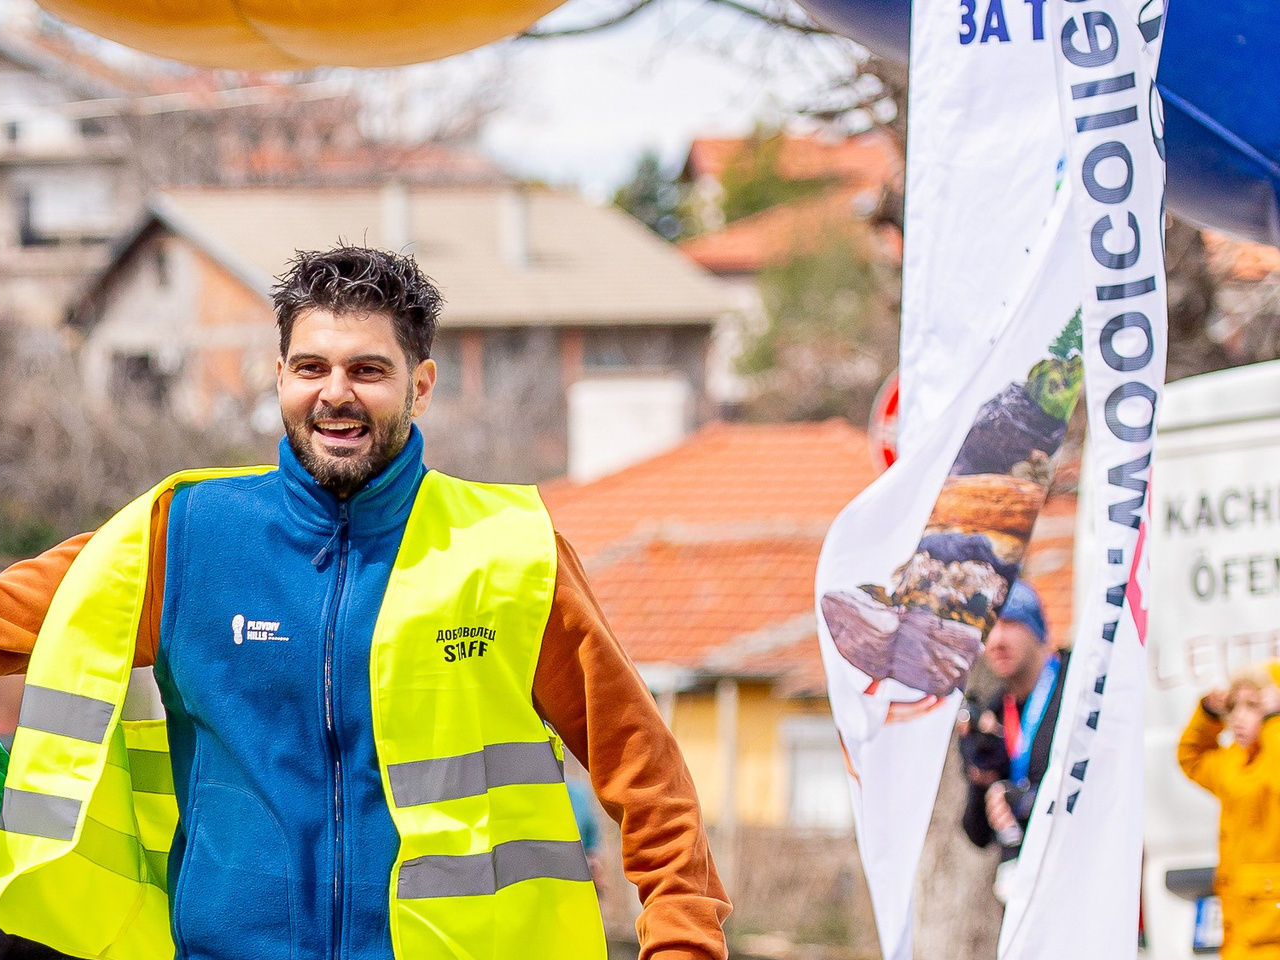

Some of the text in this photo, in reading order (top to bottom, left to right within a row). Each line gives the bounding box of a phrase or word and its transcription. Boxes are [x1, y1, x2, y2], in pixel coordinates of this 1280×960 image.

[1164, 483, 1280, 535] KACH
[1190, 548, 1280, 602] ÖFE
[247, 631, 268, 641] HILLS
[443, 640, 489, 663] STAFF
